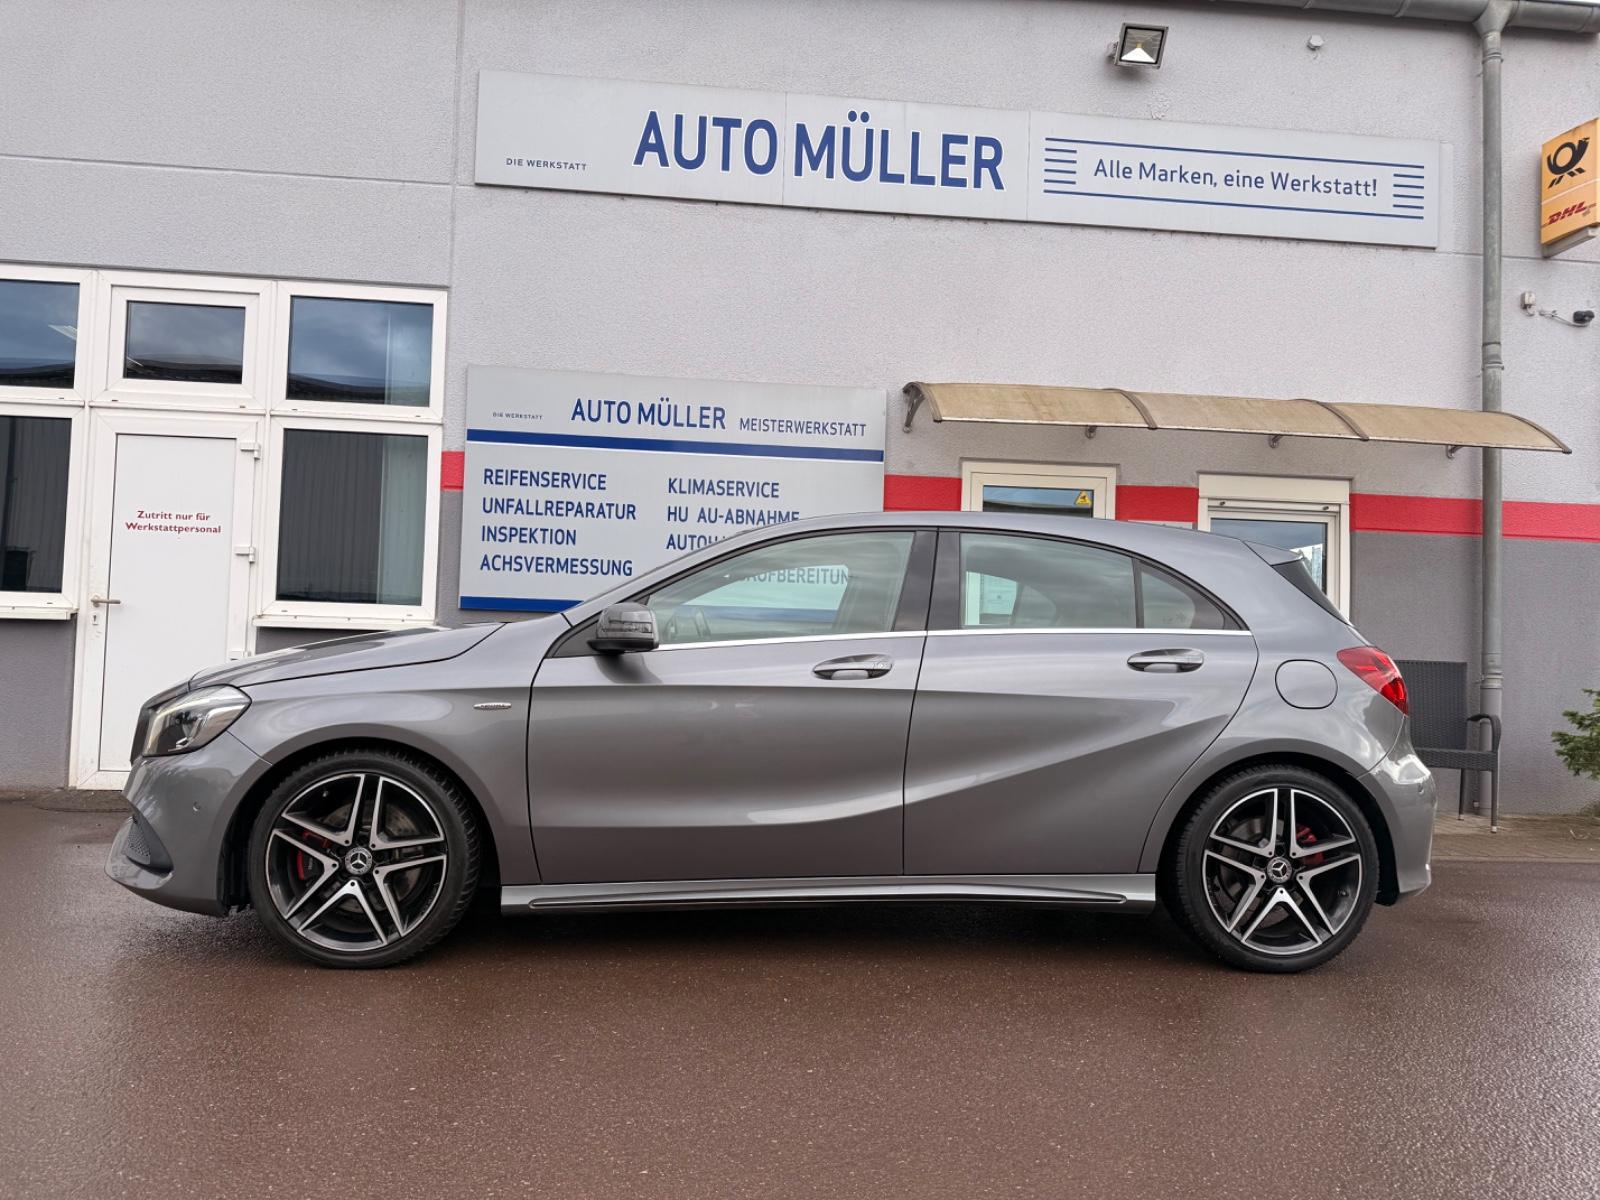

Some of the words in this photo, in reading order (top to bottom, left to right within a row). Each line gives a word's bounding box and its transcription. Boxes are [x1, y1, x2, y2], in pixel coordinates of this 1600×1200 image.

[634, 111, 777, 174] AUTO
[795, 111, 1004, 190] MÜLLER
[505, 157, 524, 167] DIE
[526, 159, 587, 171] WERKSTATT
[1094, 159, 1132, 179] Alle
[1139, 162, 1217, 187] Marken,
[1224, 170, 1264, 188] eine
[1271, 172, 1376, 196] Werkstatt!
[1548, 201, 1587, 224] DHL
[571, 398, 631, 424] AUTO
[638, 397, 725, 429] MÜLLER
[740, 418, 866, 436] MEISTERWERKSTATT
[484, 468, 606, 490] REIFENSERVICE
[669, 478, 779, 498] KLIMASERVICE
[137, 510, 173, 520] Zutritt
[175, 513, 194, 521] nur
[195, 512, 211, 521] für
[483, 497, 636, 520] UNFALLREPARATUR
[668, 506, 688, 522] HU
[124, 521, 222, 535] Werkstattpersonal
[482, 525, 576, 545] INSPEKTION
[480, 554, 632, 576] ACHSVERMESSUNG
